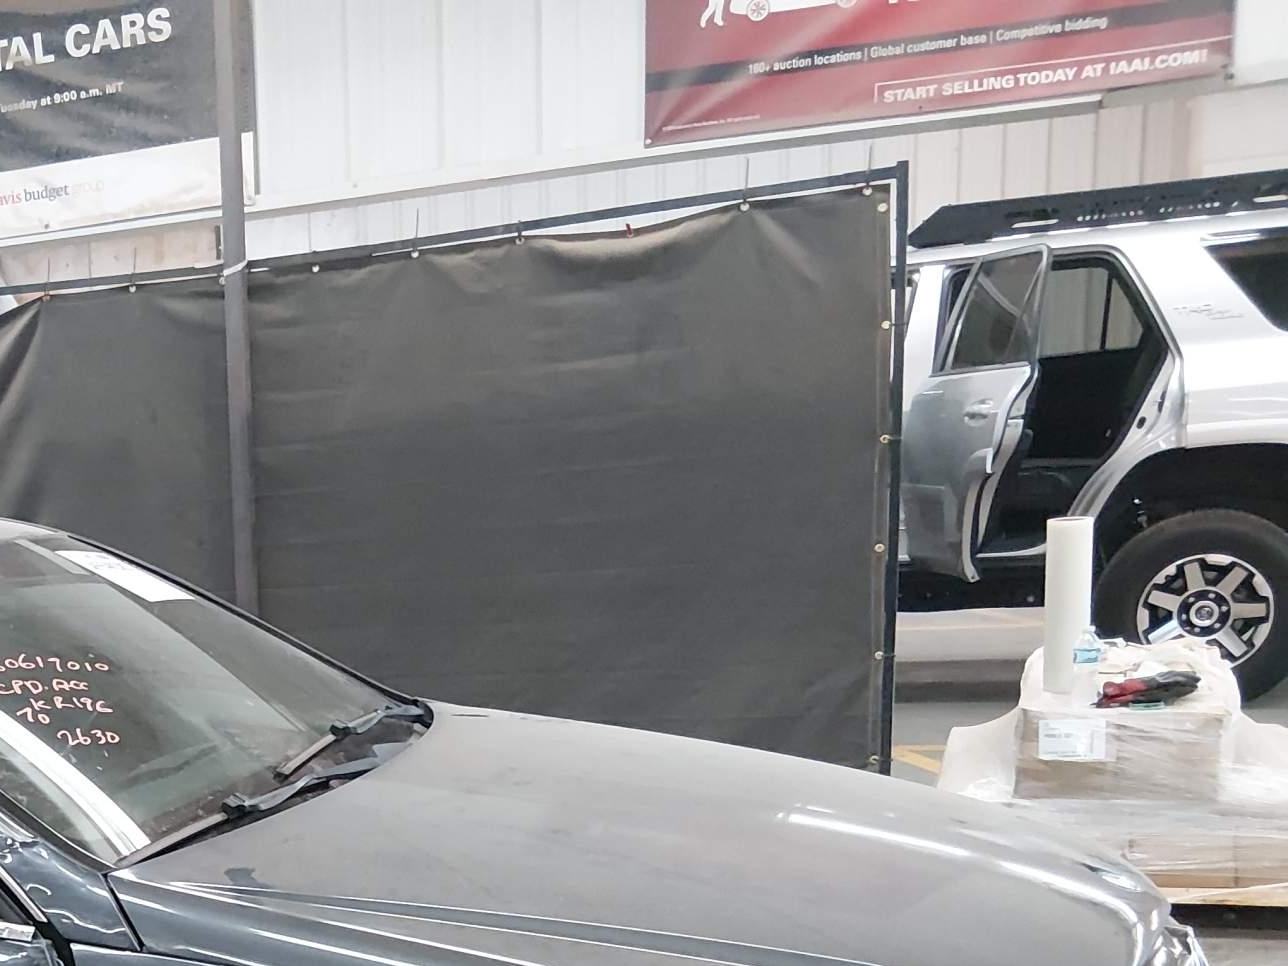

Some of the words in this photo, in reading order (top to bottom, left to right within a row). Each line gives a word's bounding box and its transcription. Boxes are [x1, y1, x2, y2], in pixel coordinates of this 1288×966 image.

[65, 7, 173, 58] CARS
[773, 56, 812, 71] auction
[814, 50, 862, 65] locations
[870, 42, 905, 58] Global
[907, 36, 958, 53] customer
[960, 34, 987, 46] base
[996, 22, 1062, 42] Competitive
[1065, 15, 1109, 32] bidding
[883, 84, 939, 104] START
[942, 74, 1015, 96] SELLING
[1016, 66, 1078, 87] TODAY
[1080, 62, 1106, 80] AT
[1109, 49, 1209, 76] IAAI.COM!
[40, 96, 52, 106] at
[53, 91, 78, 104] 9:00
[80, 87, 103, 99] a.m.
[24, 183, 70, 203] budget
[56, 728, 121, 747] 2630
